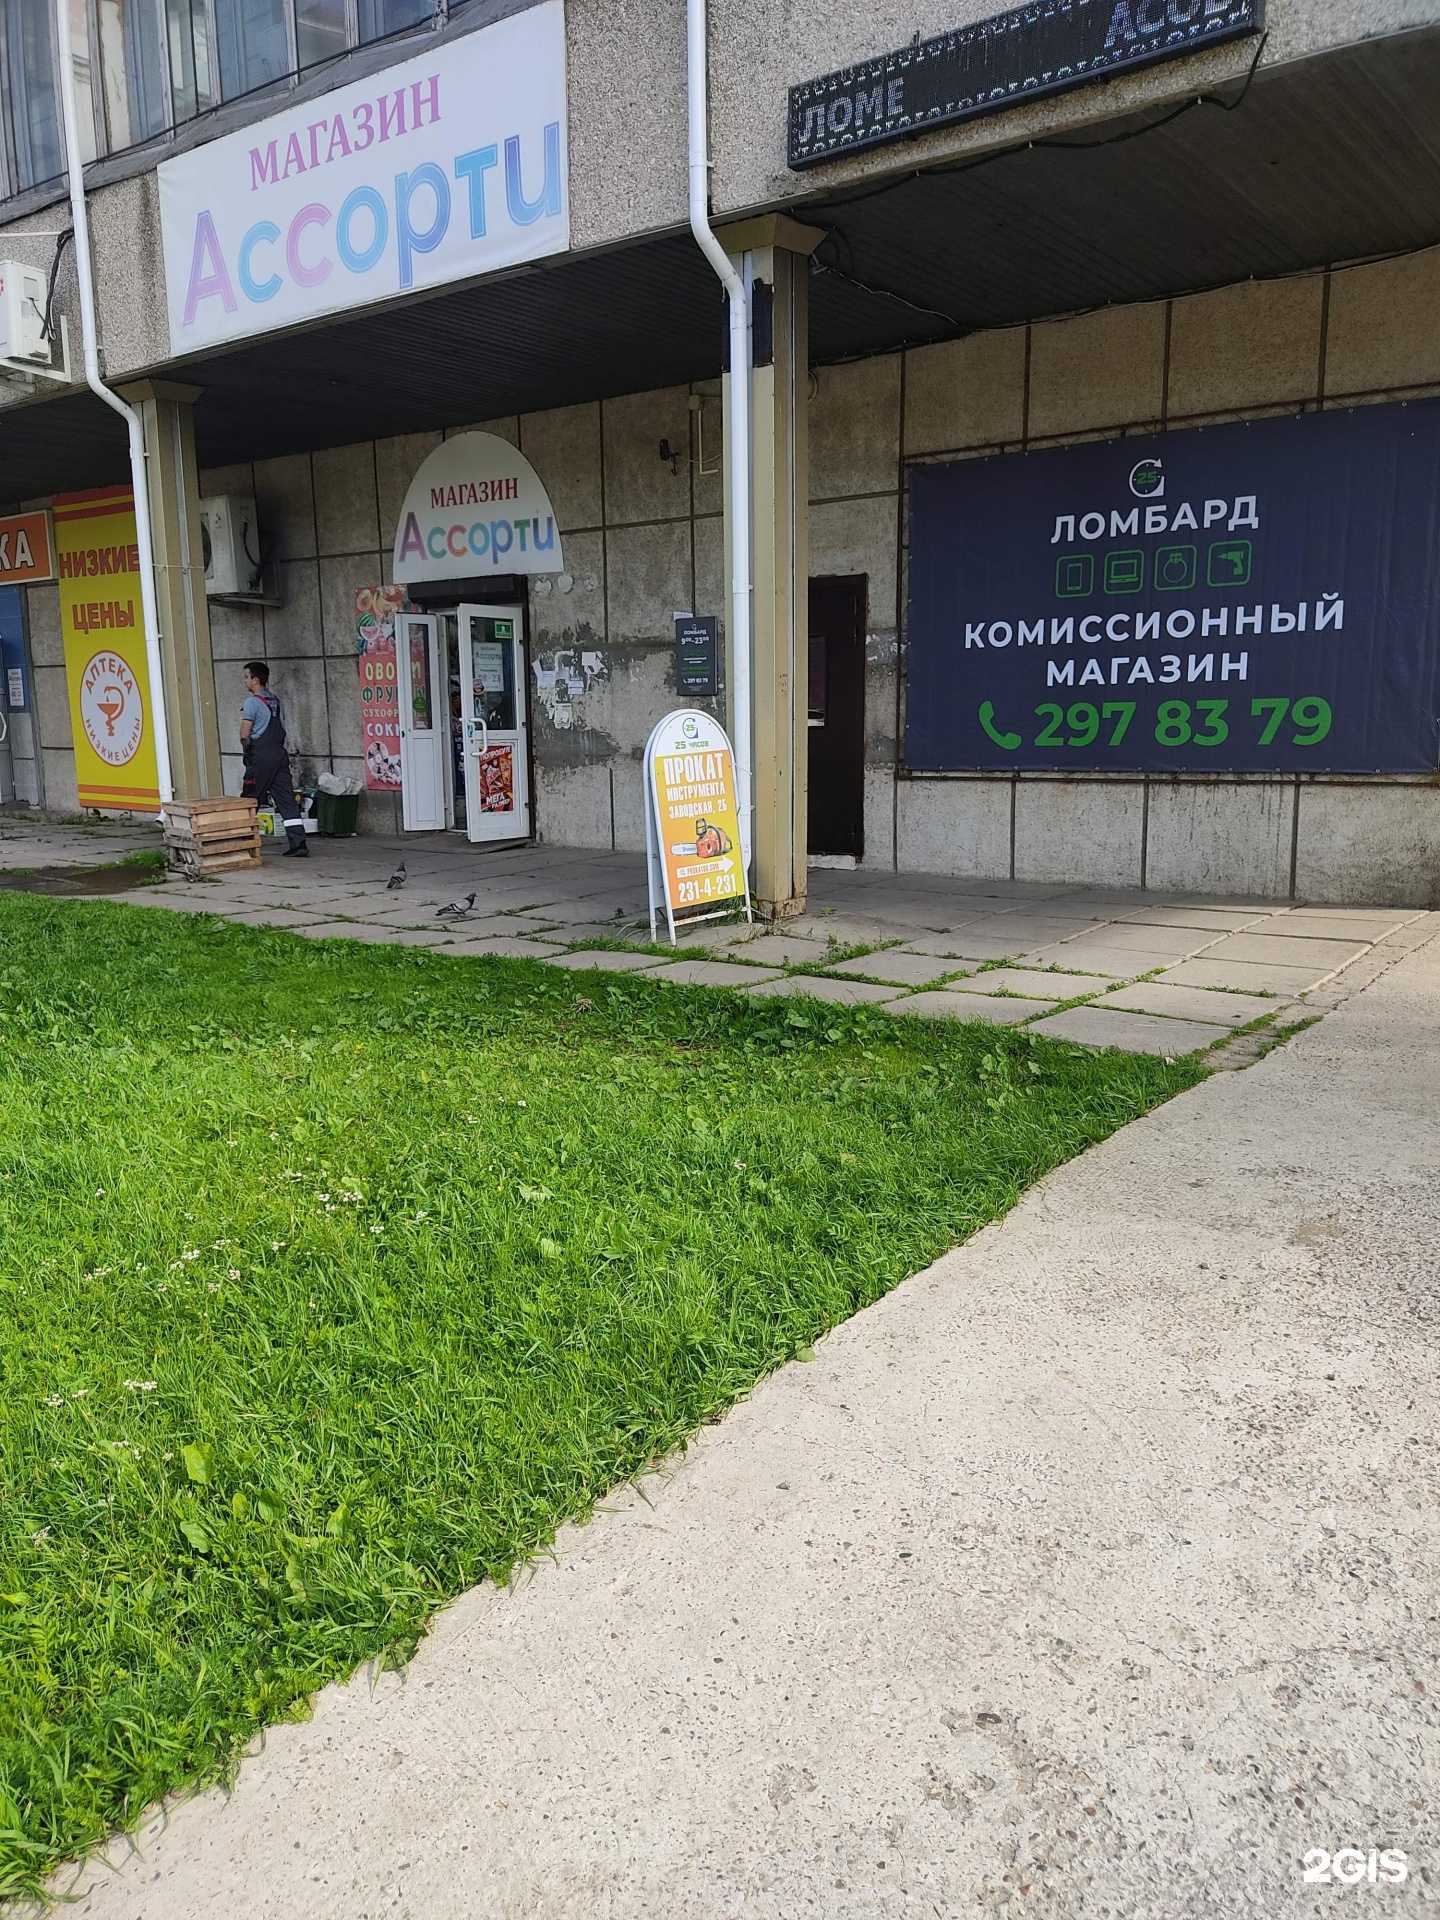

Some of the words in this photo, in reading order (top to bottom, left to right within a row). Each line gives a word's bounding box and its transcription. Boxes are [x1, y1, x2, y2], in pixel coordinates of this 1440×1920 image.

[249, 74, 442, 191] МАГАЗИН
[182, 120, 562, 328] Ассорти
[430, 478, 519, 508] МАГАЗИН
[1051, 495, 1259, 544] ЛОМБАРД
[399, 512, 554, 564] Ассорти
[59, 544, 140, 578] НИЗКИЕ
[72, 600, 135, 634] ЦЕНЫ
[964, 592, 1345, 649] КОМИССИОННЫЙ
[85, 657, 133, 695] АПТЕКА
[1046, 651, 1249, 687] МАГАЗИН
[1033, 701, 1137, 747] 297
[1154, 699, 1229, 747] 83
[1251, 696, 1334, 747] 79
[675, 741, 686, 750] 25
[664, 752, 724, 785] ПРОКАТ
[666, 782, 726, 802] ИНСТРУМЕНТА
[679, 873, 737, 903] 231-4-231
